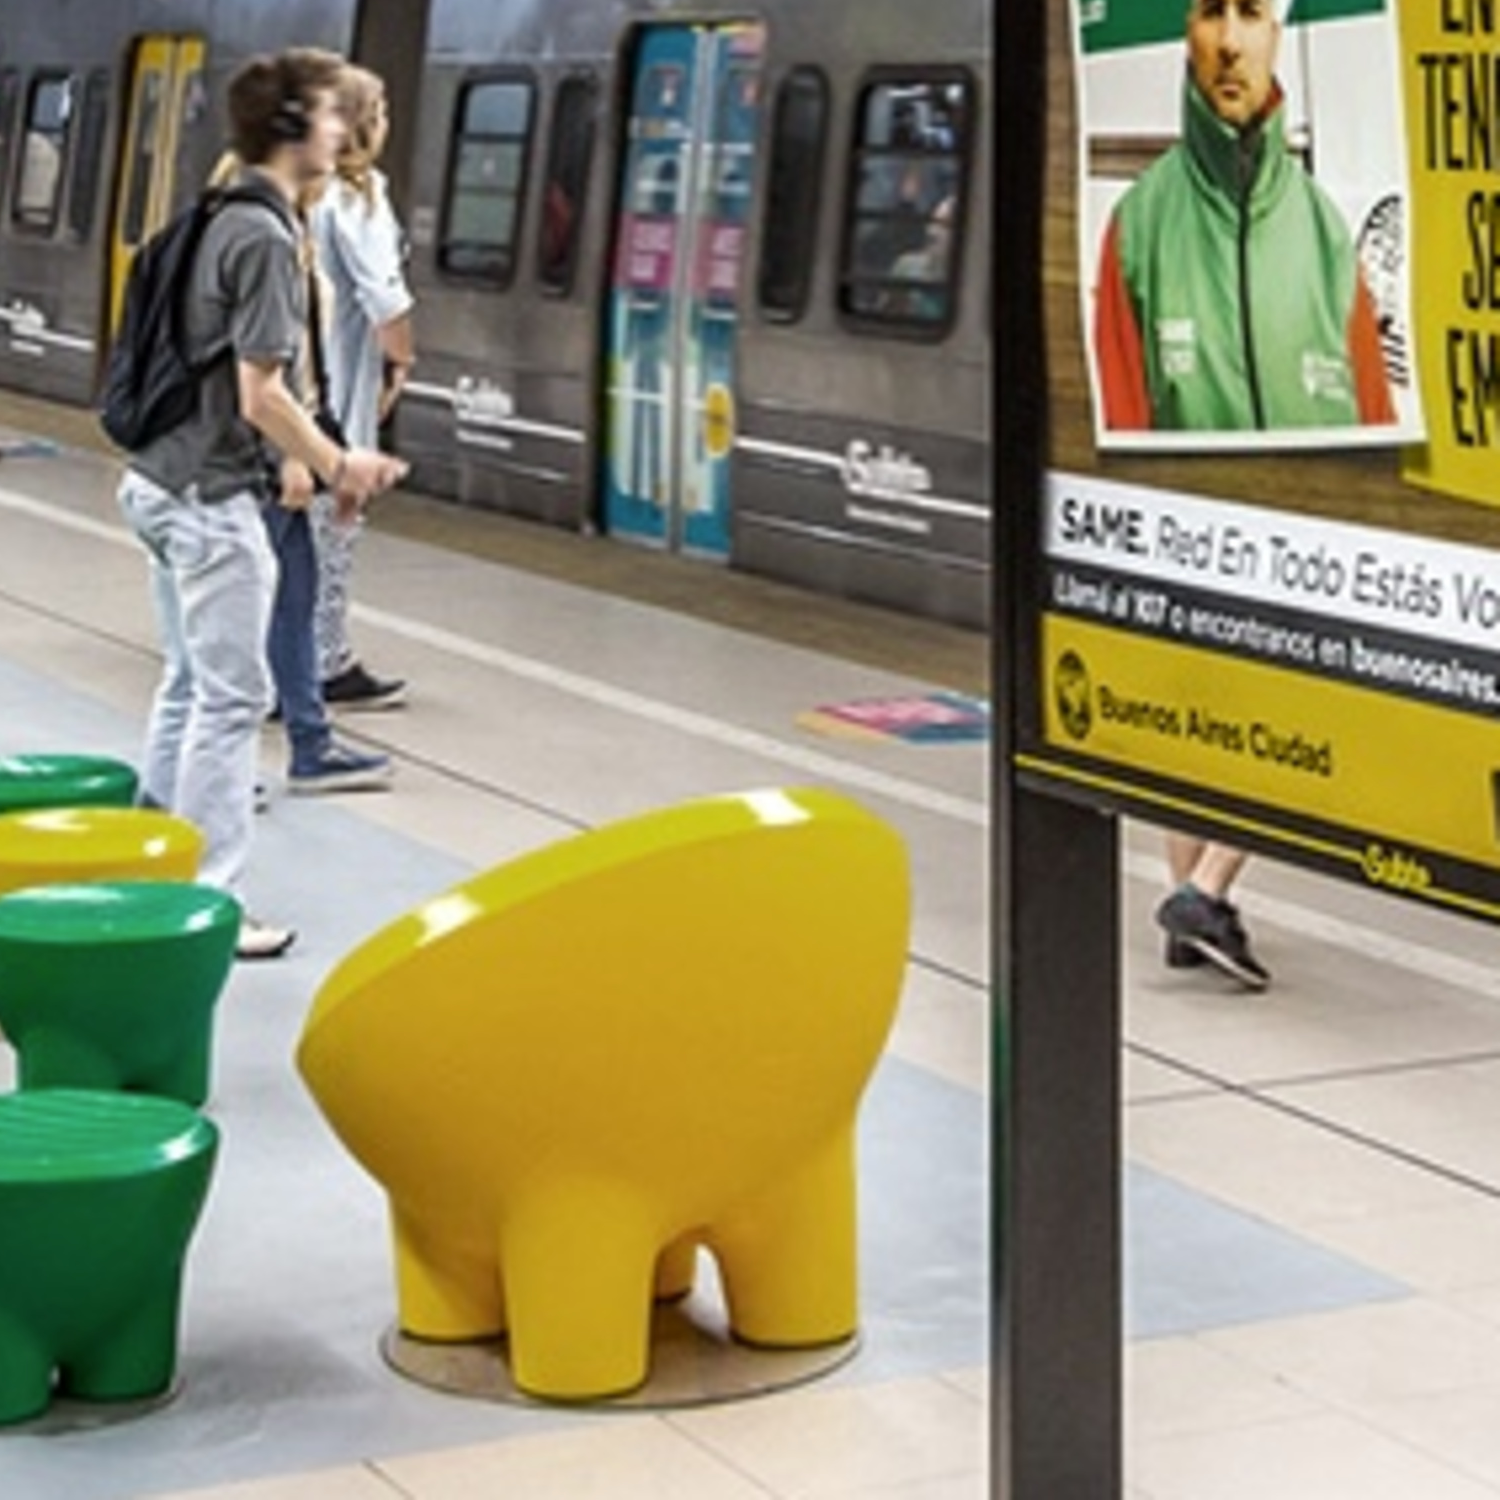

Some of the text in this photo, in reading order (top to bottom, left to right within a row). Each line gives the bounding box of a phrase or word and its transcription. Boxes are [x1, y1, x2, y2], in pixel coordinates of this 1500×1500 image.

[1417, 53, 1500, 172] TEN
[1155, 514, 1214, 570] Red
[1218, 526, 1258, 578] En
[1269, 535, 1346, 597] Todo
[1351, 552, 1442, 618] Estás
[1318, 637, 1348, 669] en
[1099, 685, 1332, 778] Buenos Aires Ciudad
